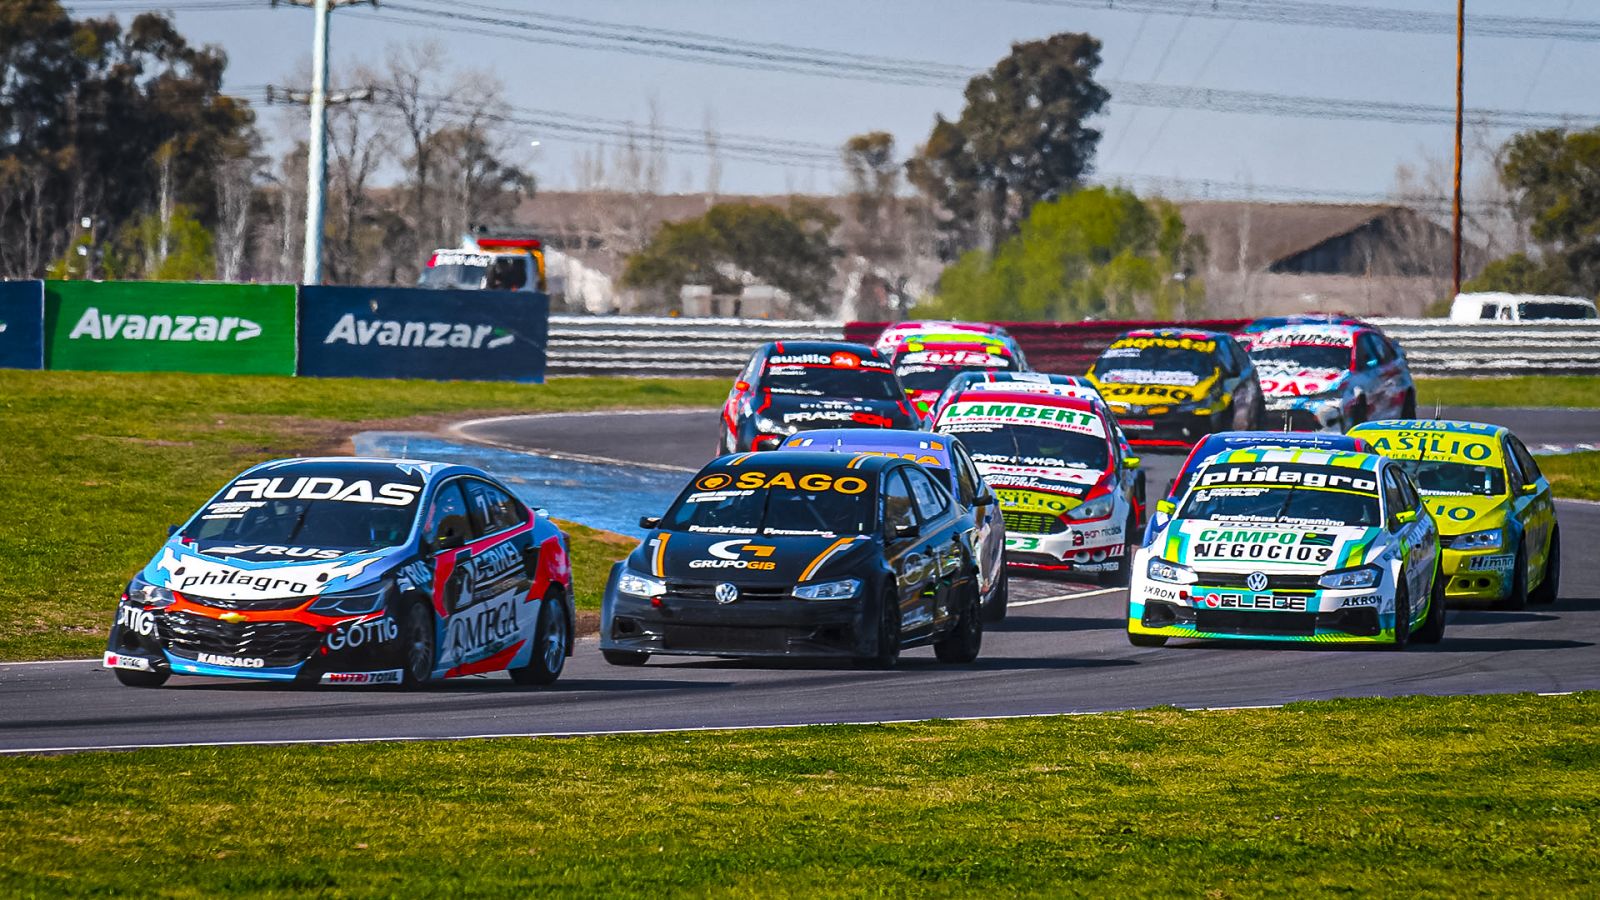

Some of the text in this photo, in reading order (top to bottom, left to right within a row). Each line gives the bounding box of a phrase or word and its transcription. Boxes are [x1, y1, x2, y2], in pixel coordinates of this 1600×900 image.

[947, 404, 1097, 426] LAMBERT
[1397, 431, 1446, 439] DON
[1373, 436, 1492, 461] ASILIO
[735, 471, 868, 495] SAGO
[1201, 465, 1377, 492] philagro
[223, 476, 422, 507] RUDAS
[1199, 530, 1298, 545] CAMPO
[254, 544, 345, 559] RUS
[1194, 543, 1334, 562] NEGOCIOS
[180, 569, 308, 594] philagro
[1341, 595, 1383, 607] AKRON
[117, 602, 155, 636] TTIG
[197, 653, 265, 668] KANSACO
